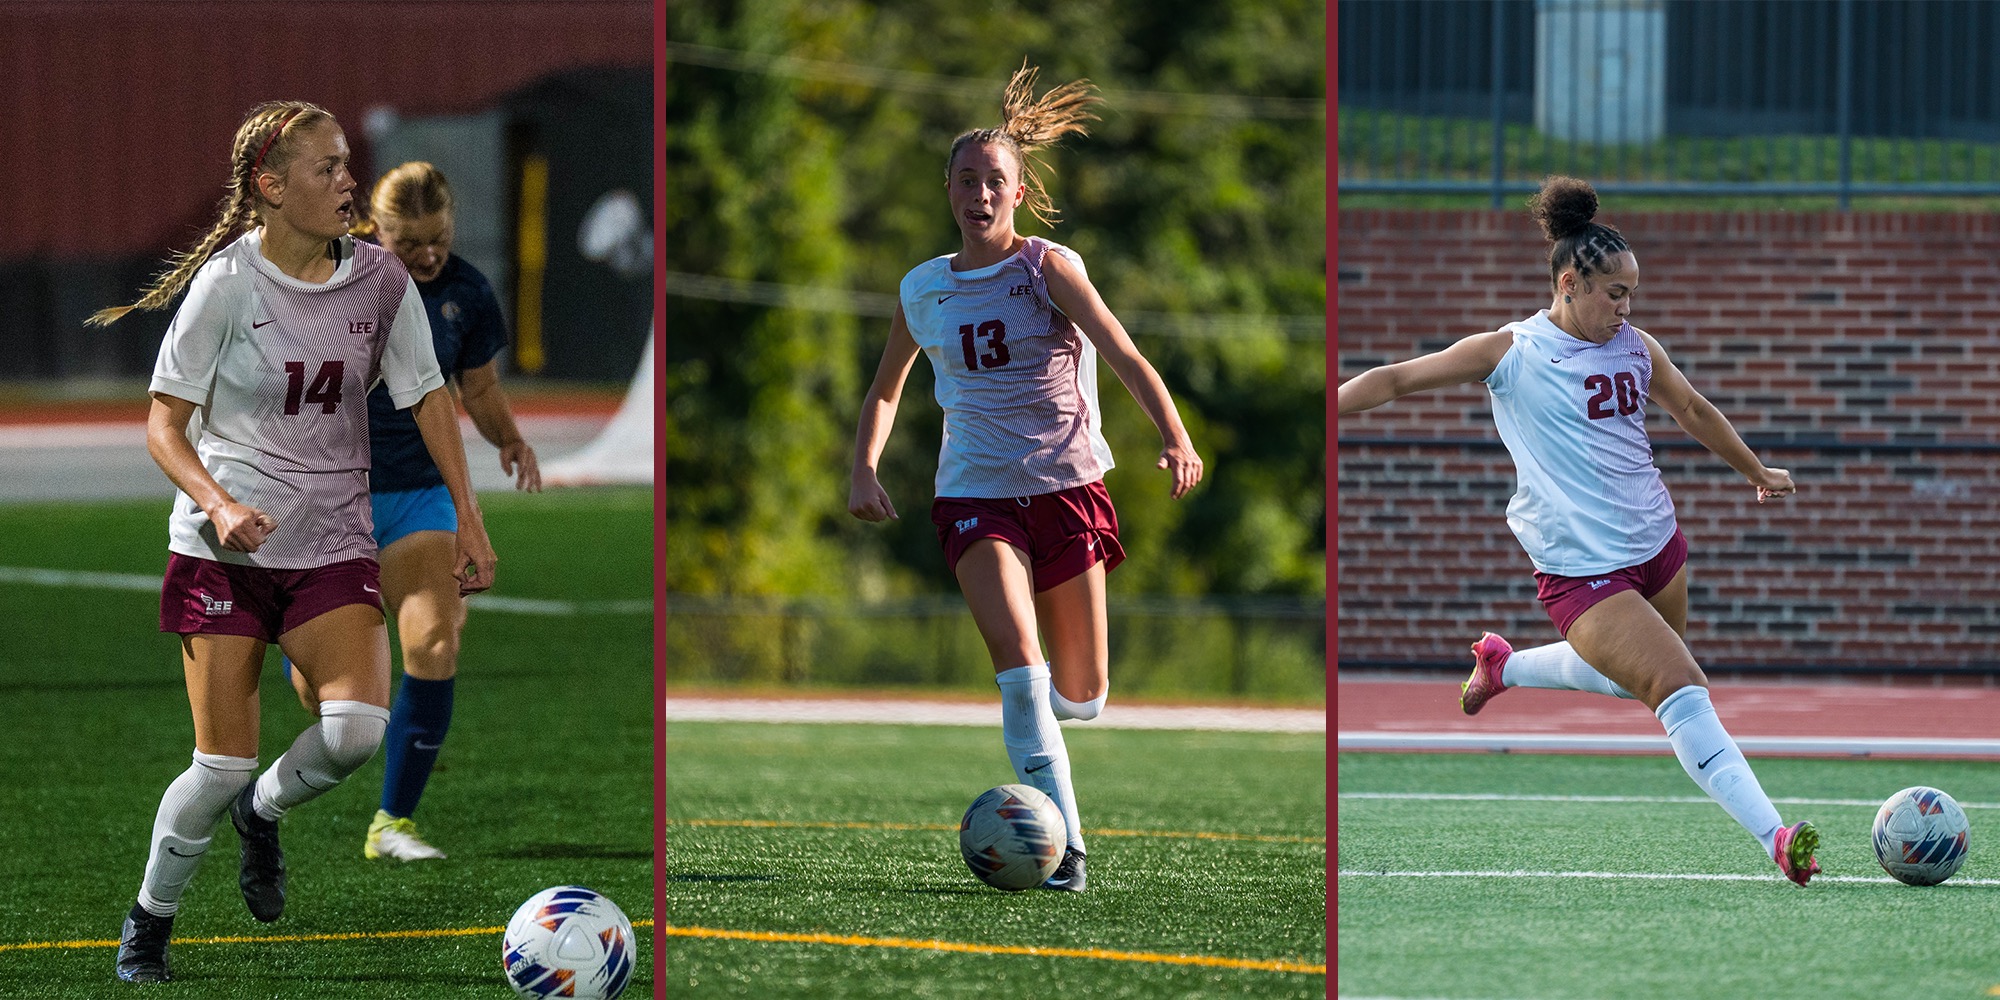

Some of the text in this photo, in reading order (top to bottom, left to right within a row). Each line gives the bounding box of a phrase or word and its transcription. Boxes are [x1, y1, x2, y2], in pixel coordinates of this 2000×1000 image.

[1009, 285, 1033, 296] LEE
[348, 321, 373, 334] LEE
[959, 319, 1011, 371] 13
[284, 361, 345, 415] 14
[1584, 371, 1640, 420] 20
[201, 593, 233, 611] LEE
